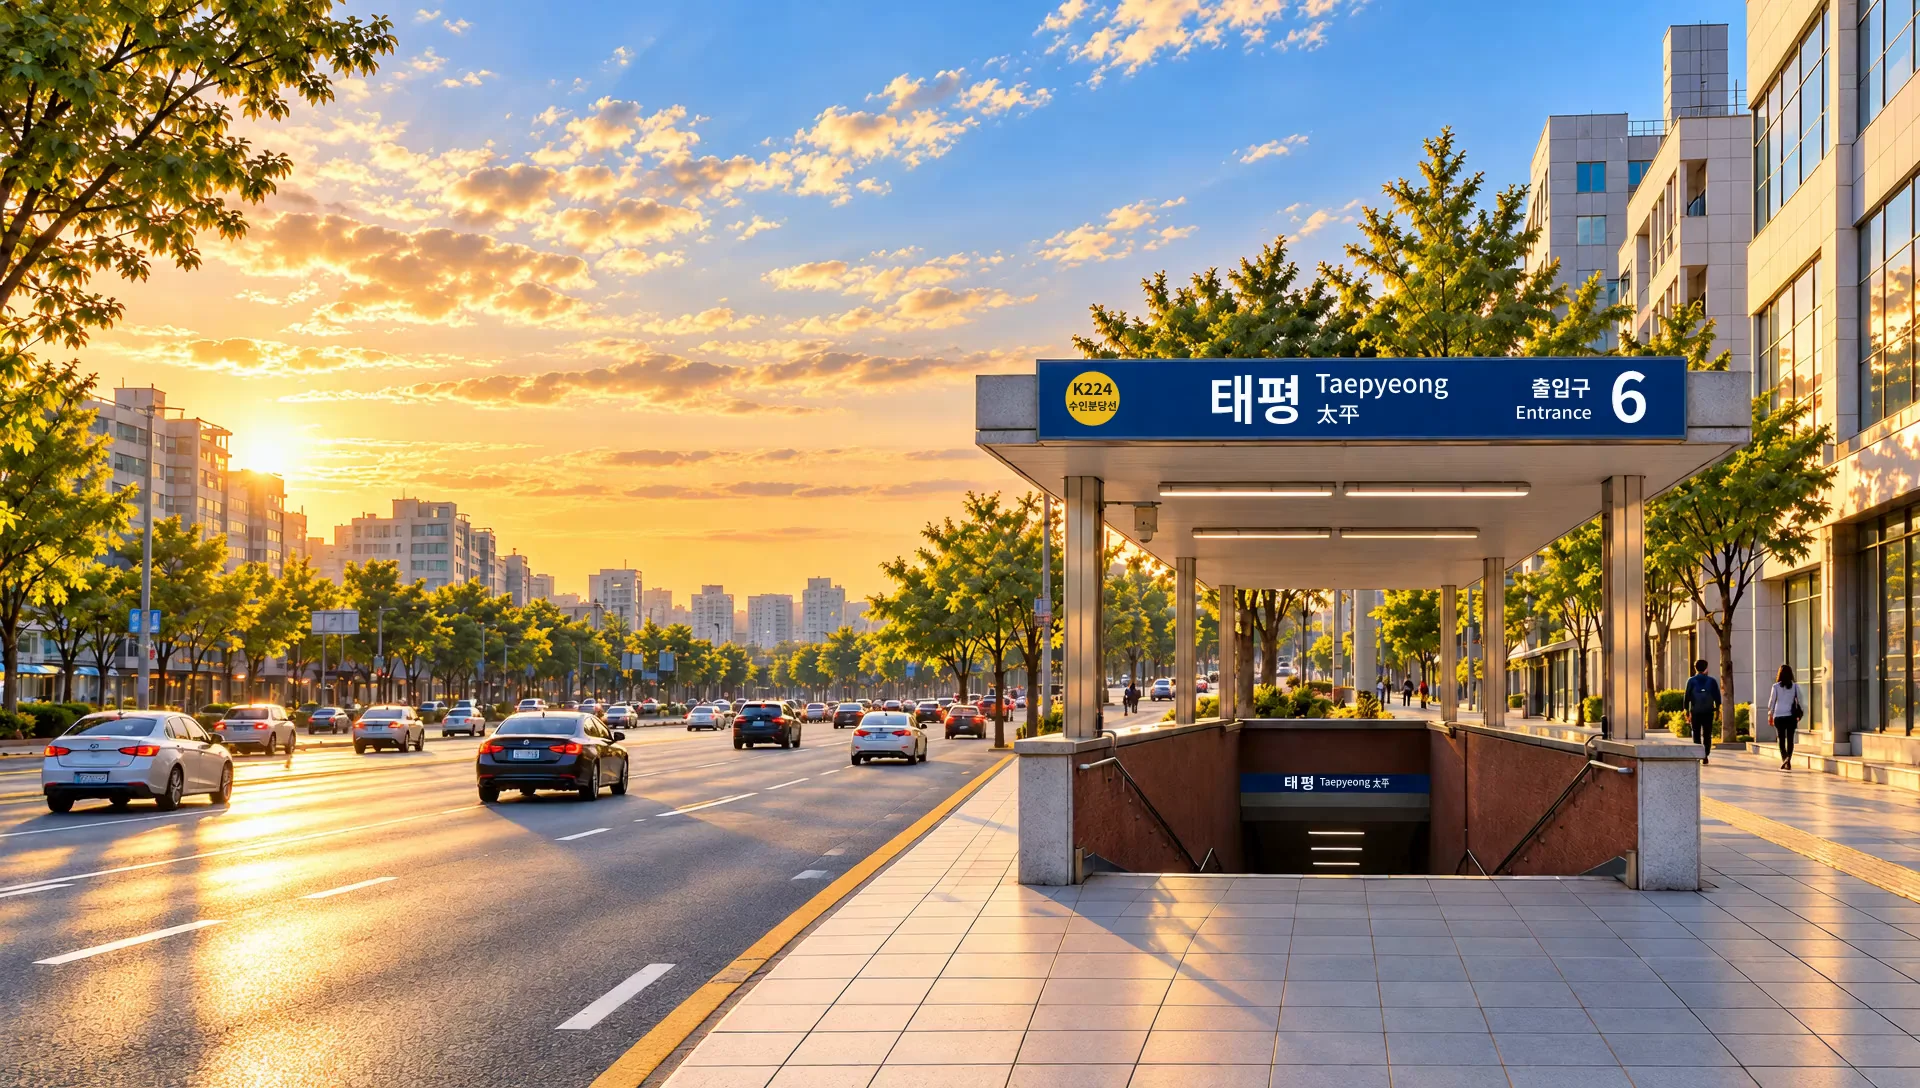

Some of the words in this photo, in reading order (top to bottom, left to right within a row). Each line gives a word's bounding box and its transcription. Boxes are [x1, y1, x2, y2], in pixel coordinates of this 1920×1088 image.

[1073, 383, 1112, 396] K224
[1316, 374, 1449, 400] Taepyeong
[1531, 377, 1591, 399] 출입구
[1612, 370, 1647, 424] 6
[1068, 400, 1118, 413] 수인분당선
[1211, 374, 1299, 425] 태평
[1316, 404, 1360, 425] 太平
[1517, 405, 1592, 420] Entrance
[1319, 777, 1371, 789] Taepyeong
[1372, 777, 1390, 789] 太平
